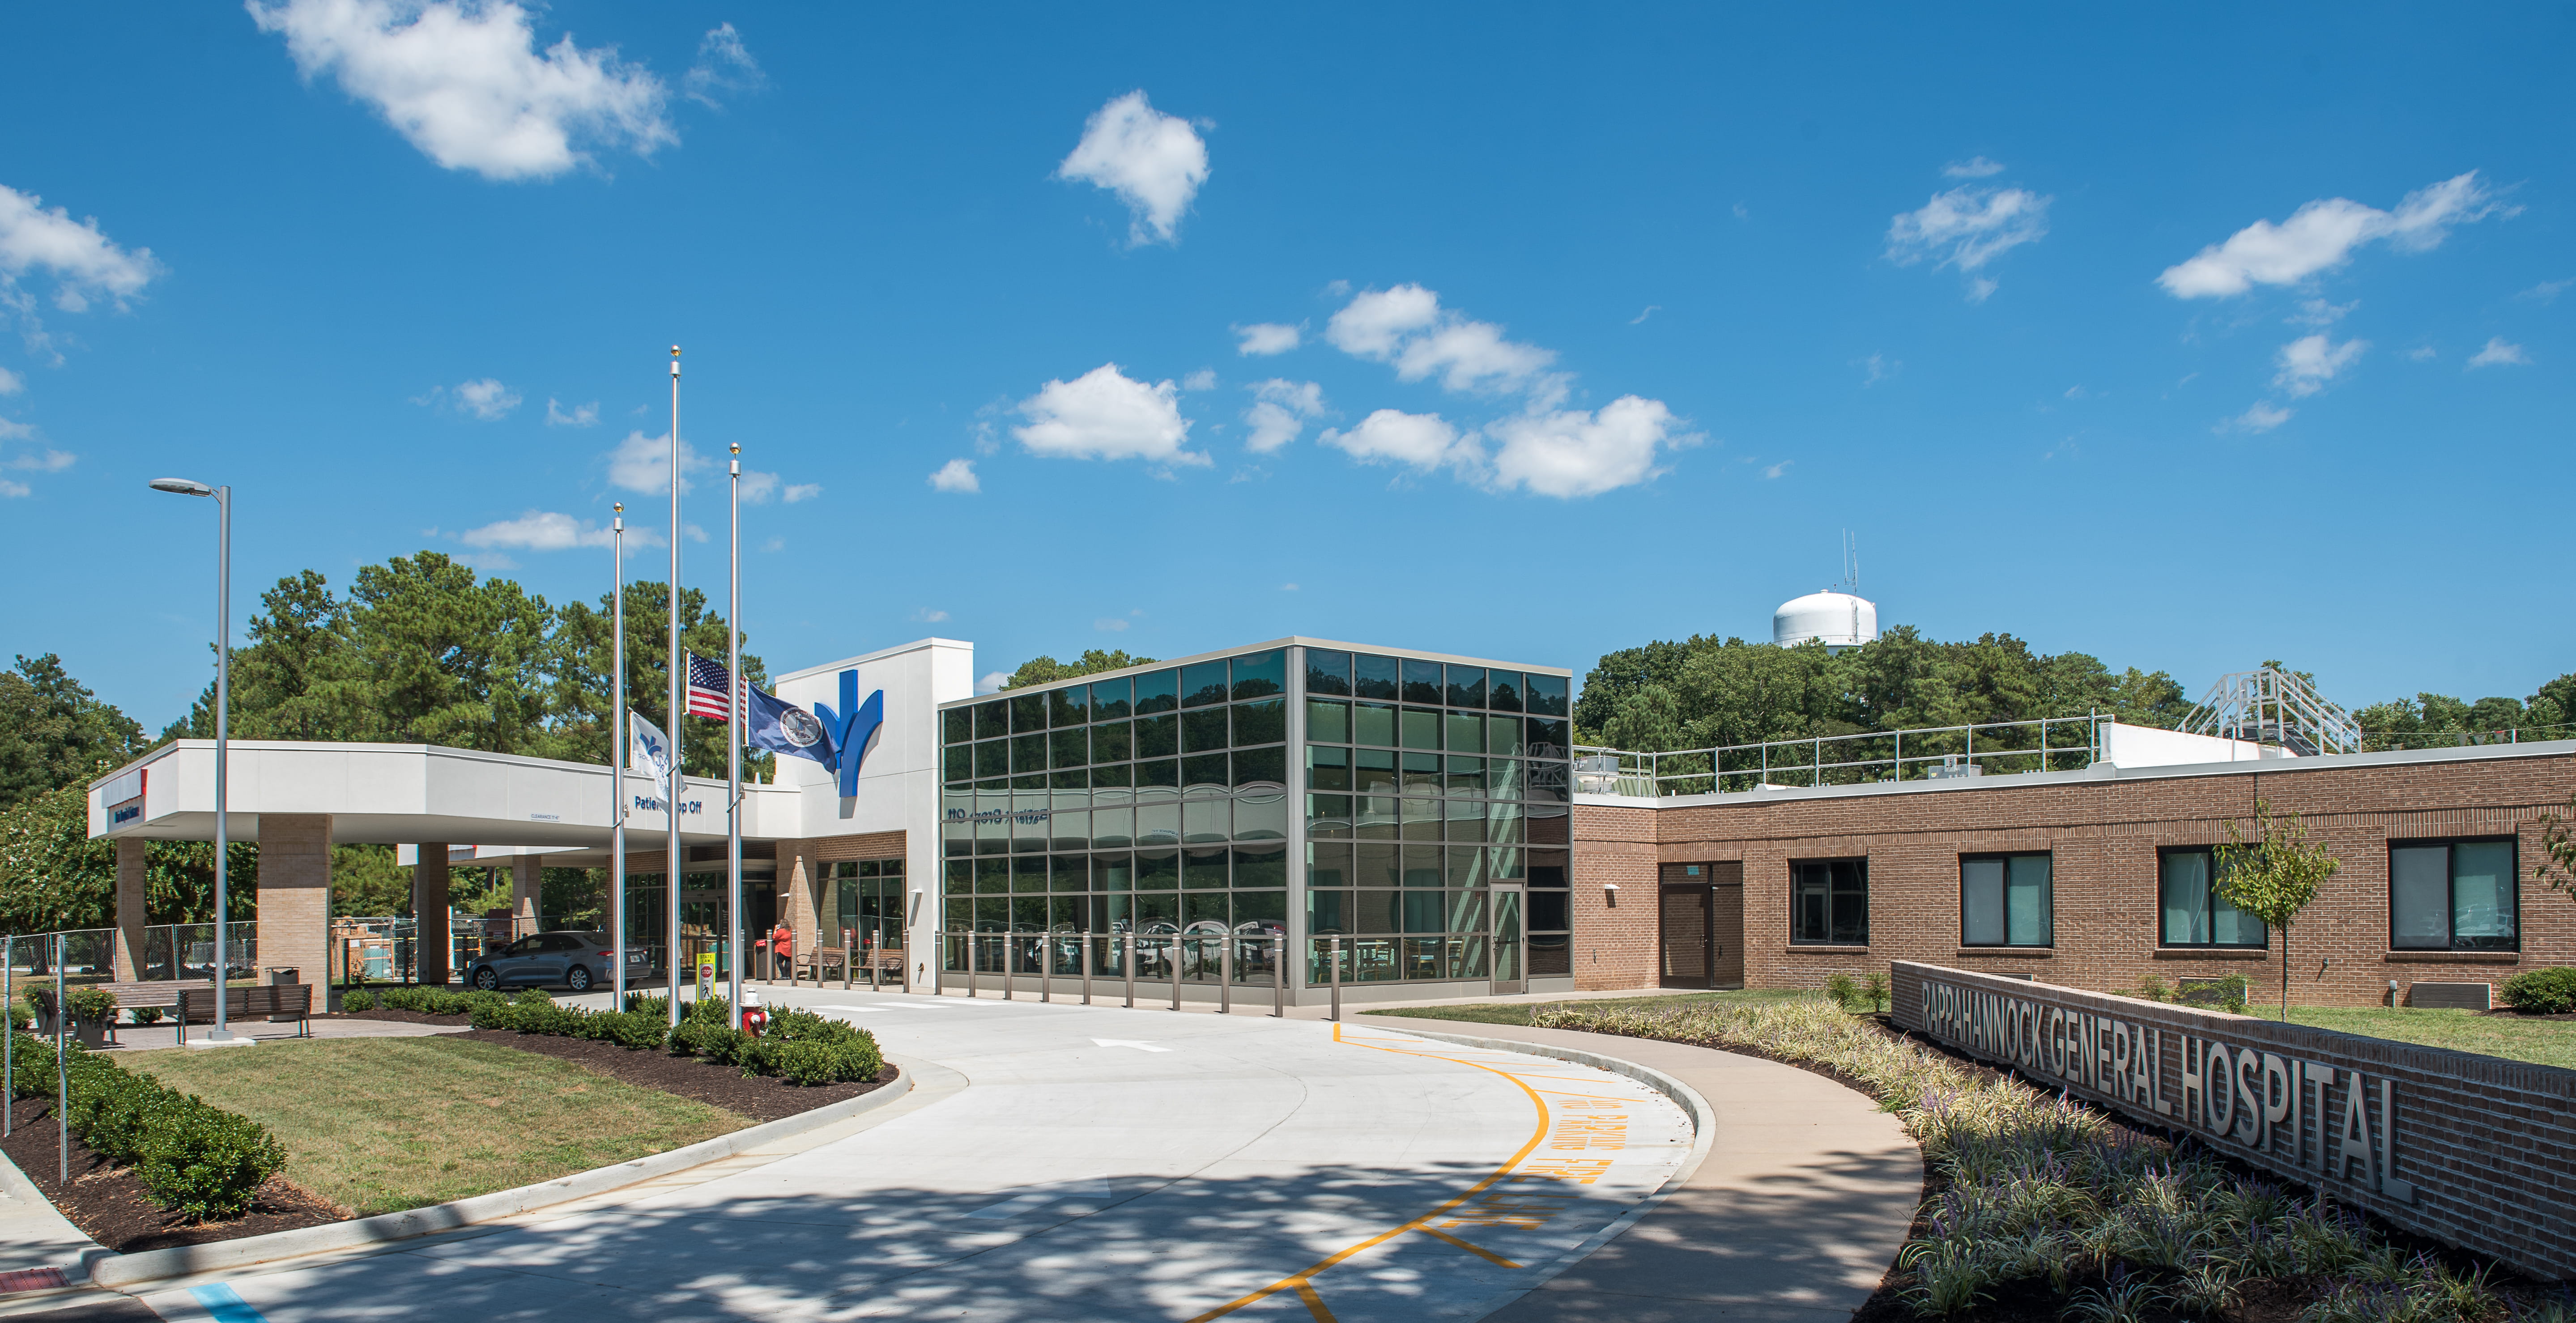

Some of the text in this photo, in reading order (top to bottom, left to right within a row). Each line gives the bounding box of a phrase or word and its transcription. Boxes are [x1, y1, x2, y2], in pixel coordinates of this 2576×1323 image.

[635, 796, 662, 812] Patie
[689, 801, 702, 815] Off
[1923, 981, 2418, 1204] RAPPAHANNOCK GENERAL HOSPITAL
[1437, 1100, 1629, 1230] NO PARKING FIRE LANE
